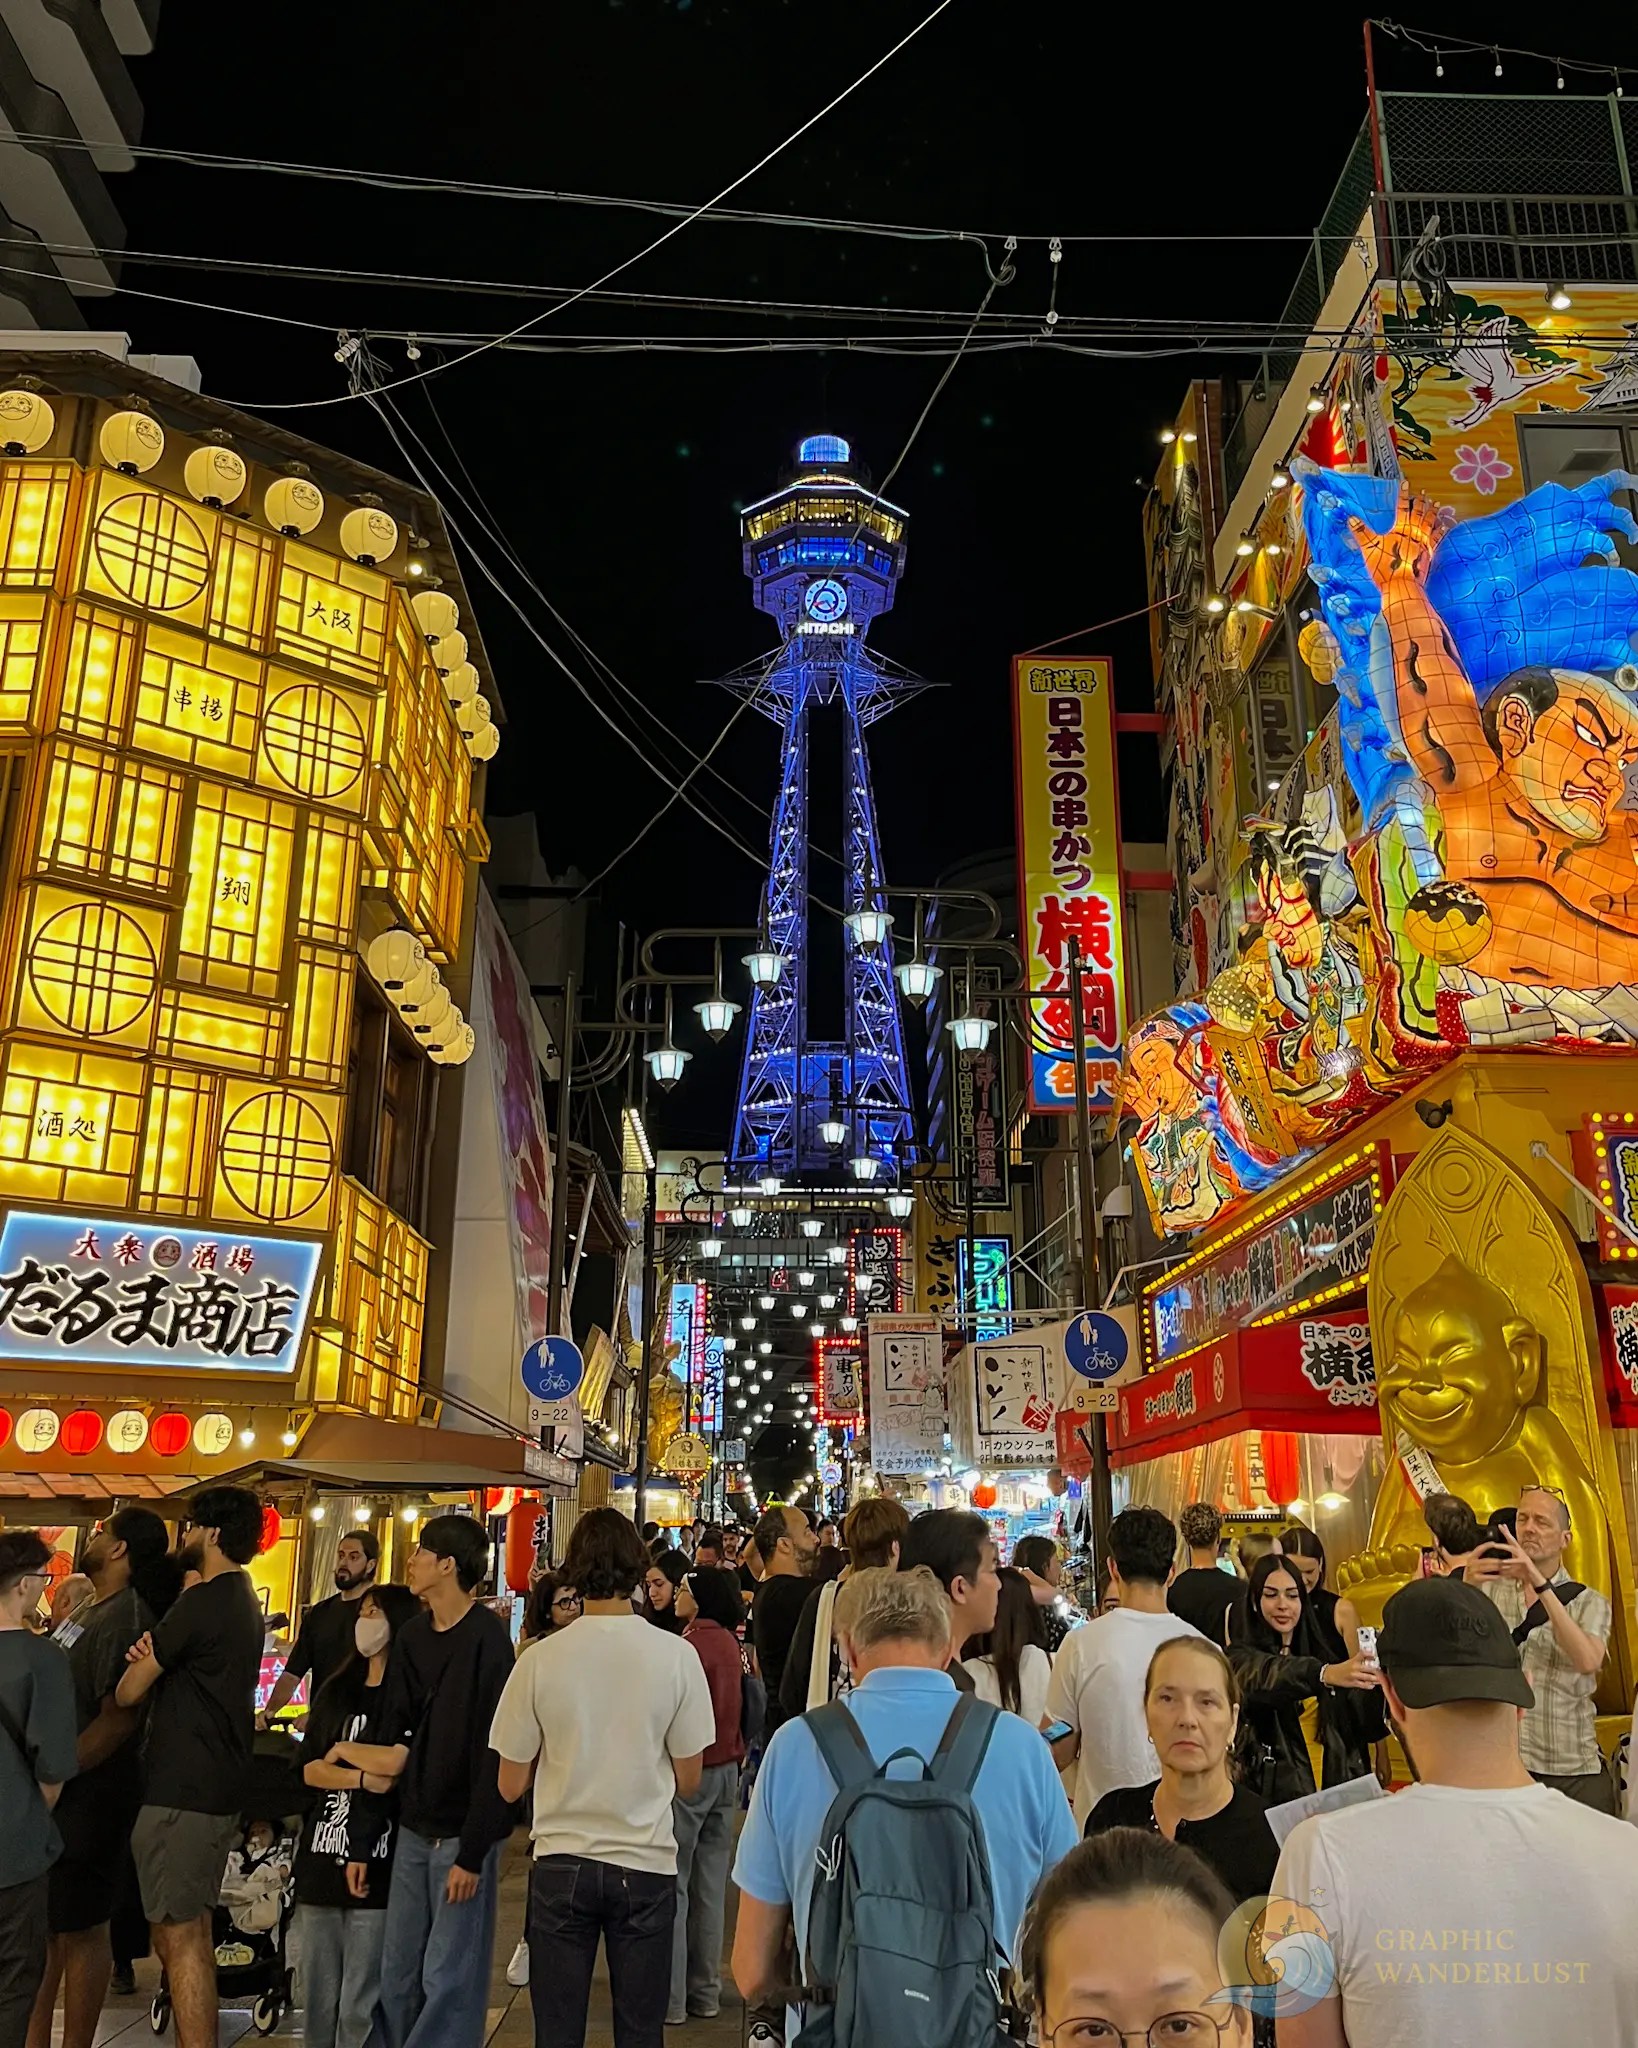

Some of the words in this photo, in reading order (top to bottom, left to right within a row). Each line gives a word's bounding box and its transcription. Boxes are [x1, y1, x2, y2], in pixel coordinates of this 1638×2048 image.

[306, 600, 354, 636] 大阪
[797, 622, 855, 635] HITACHI
[1029, 667, 1097, 694] 新世界
[172, 685, 225, 722] 串揚
[1046, 695, 1092, 892] 日本一の串かつ
[221, 876, 251, 906] 翔
[1036, 895, 1121, 1052] 横綱
[37, 1108, 97, 1142] 酒処
[70, 1228, 146, 1267] 大衆
[188, 1242, 256, 1276] 酒場
[0, 1258, 301, 1360] だるま商店
